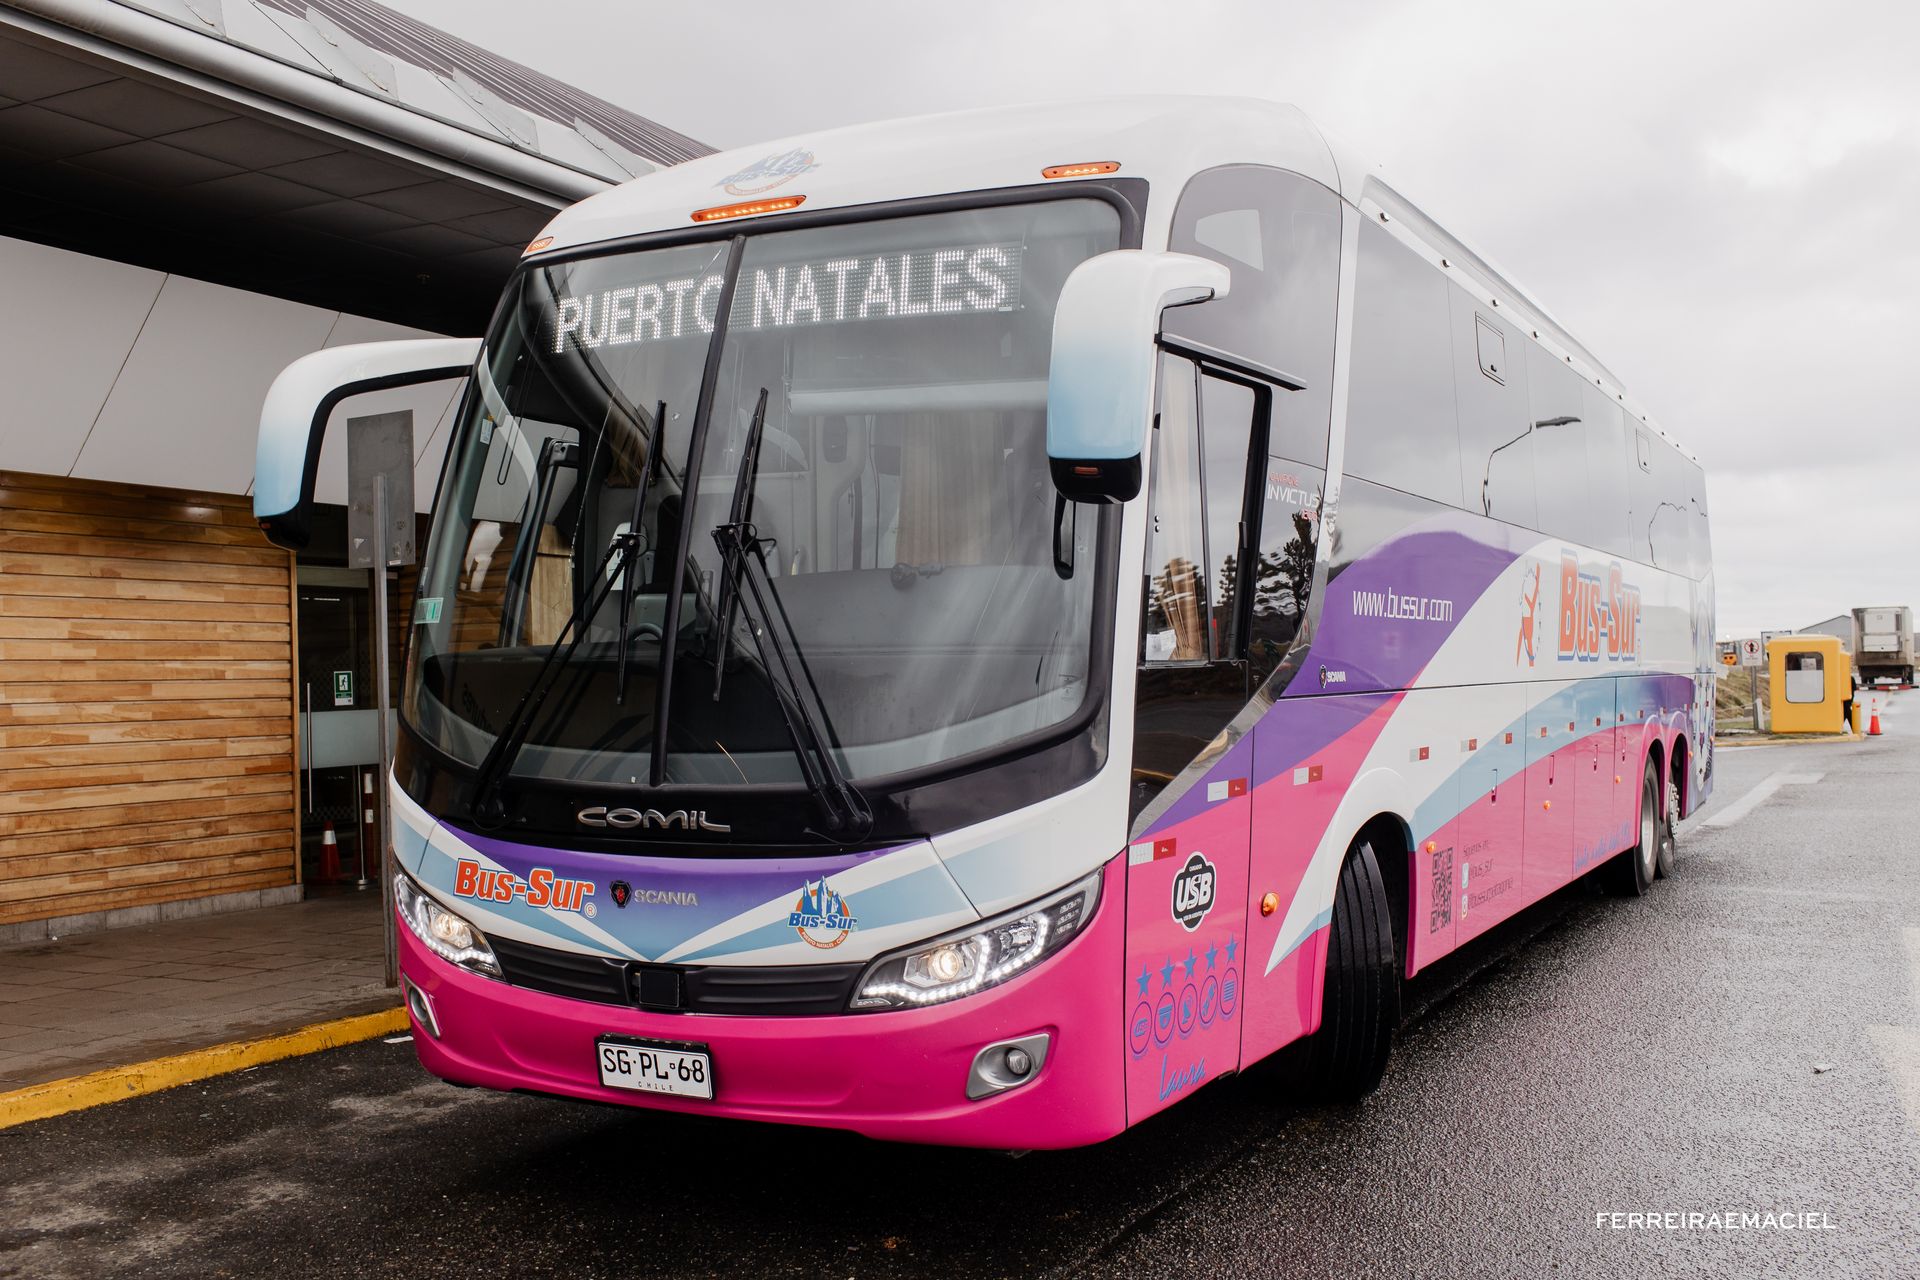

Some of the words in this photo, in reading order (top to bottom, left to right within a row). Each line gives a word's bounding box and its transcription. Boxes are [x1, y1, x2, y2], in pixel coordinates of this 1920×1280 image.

[751, 246, 1007, 328] NATALES
[1267, 484, 1319, 508] INVICTUS
[1353, 587, 1453, 621] www.bussur.com
[1558, 548, 1640, 662] Bus-Sur
[1327, 671, 1346, 683] SCANIA
[578, 806, 731, 832] COMIL
[454, 857, 596, 913] Bus-Sur
[634, 889, 698, 906] SCANIA
[1176, 872, 1213, 912] USB
[788, 912, 858, 930] Bus-Sur
[638, 1081, 674, 1092] CHILE
